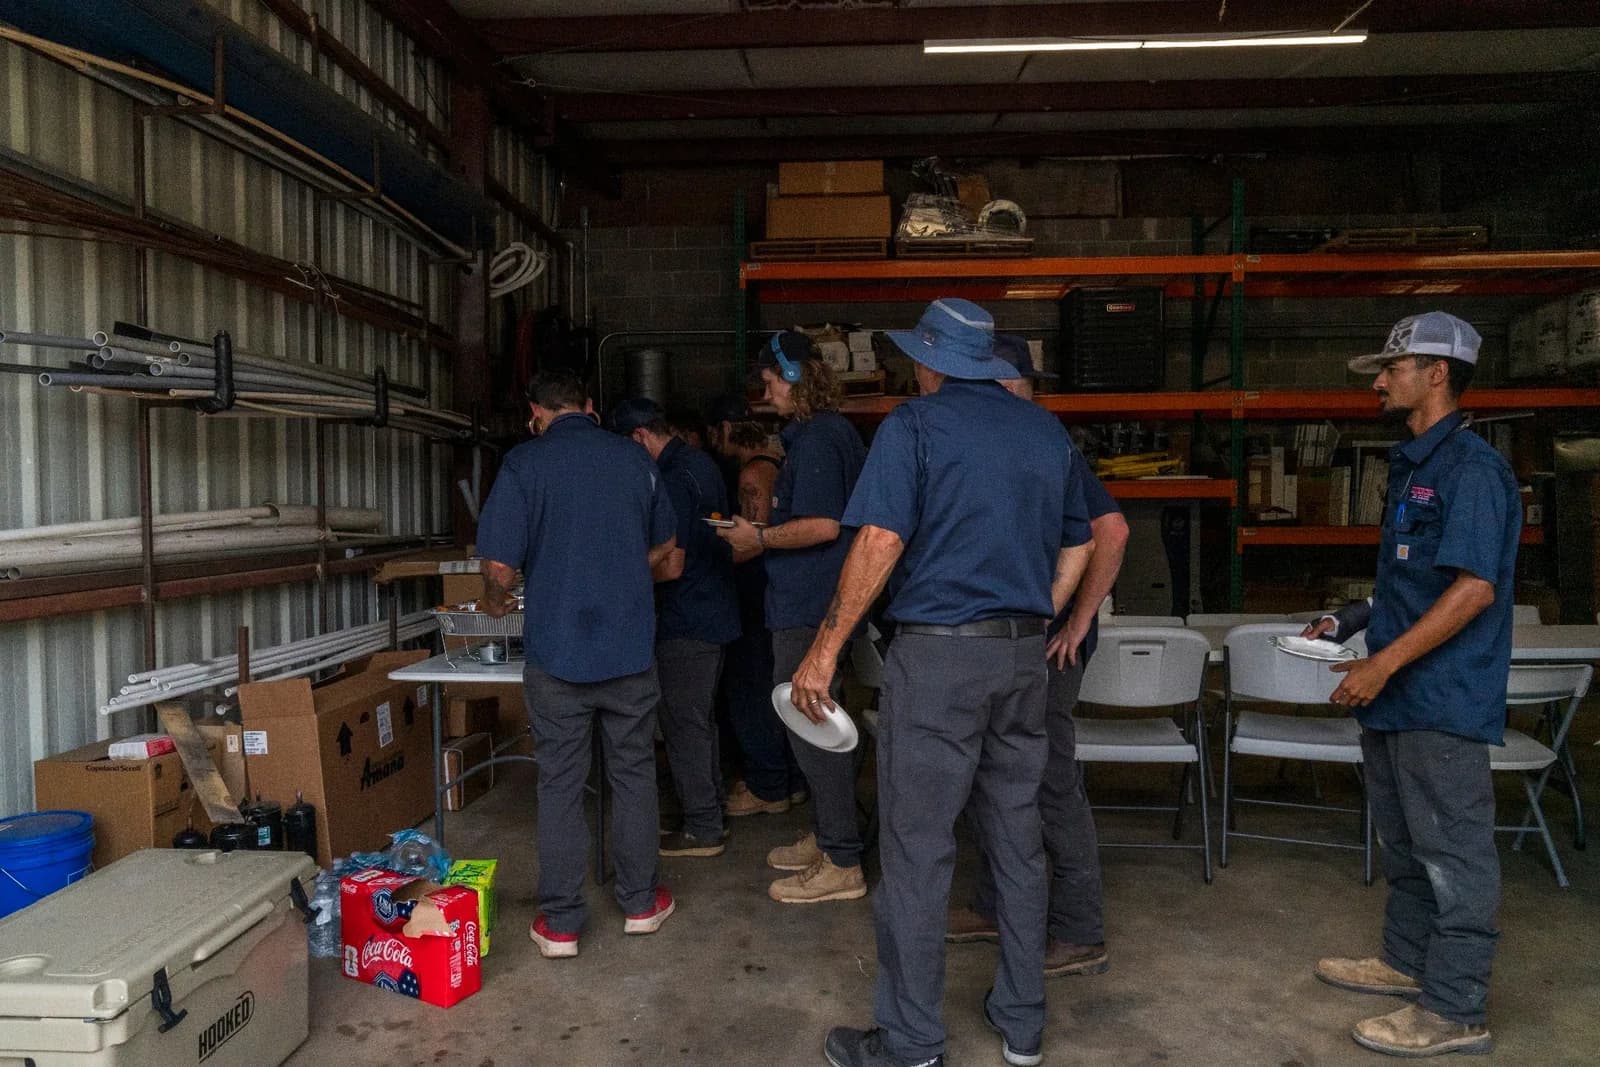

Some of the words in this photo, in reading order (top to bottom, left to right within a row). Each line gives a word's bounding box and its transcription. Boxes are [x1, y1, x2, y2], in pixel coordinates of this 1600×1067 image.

[360, 755, 405, 791] Amana
[362, 938, 414, 969] Coca-Cola
[199, 996, 250, 1060] HOOKED
